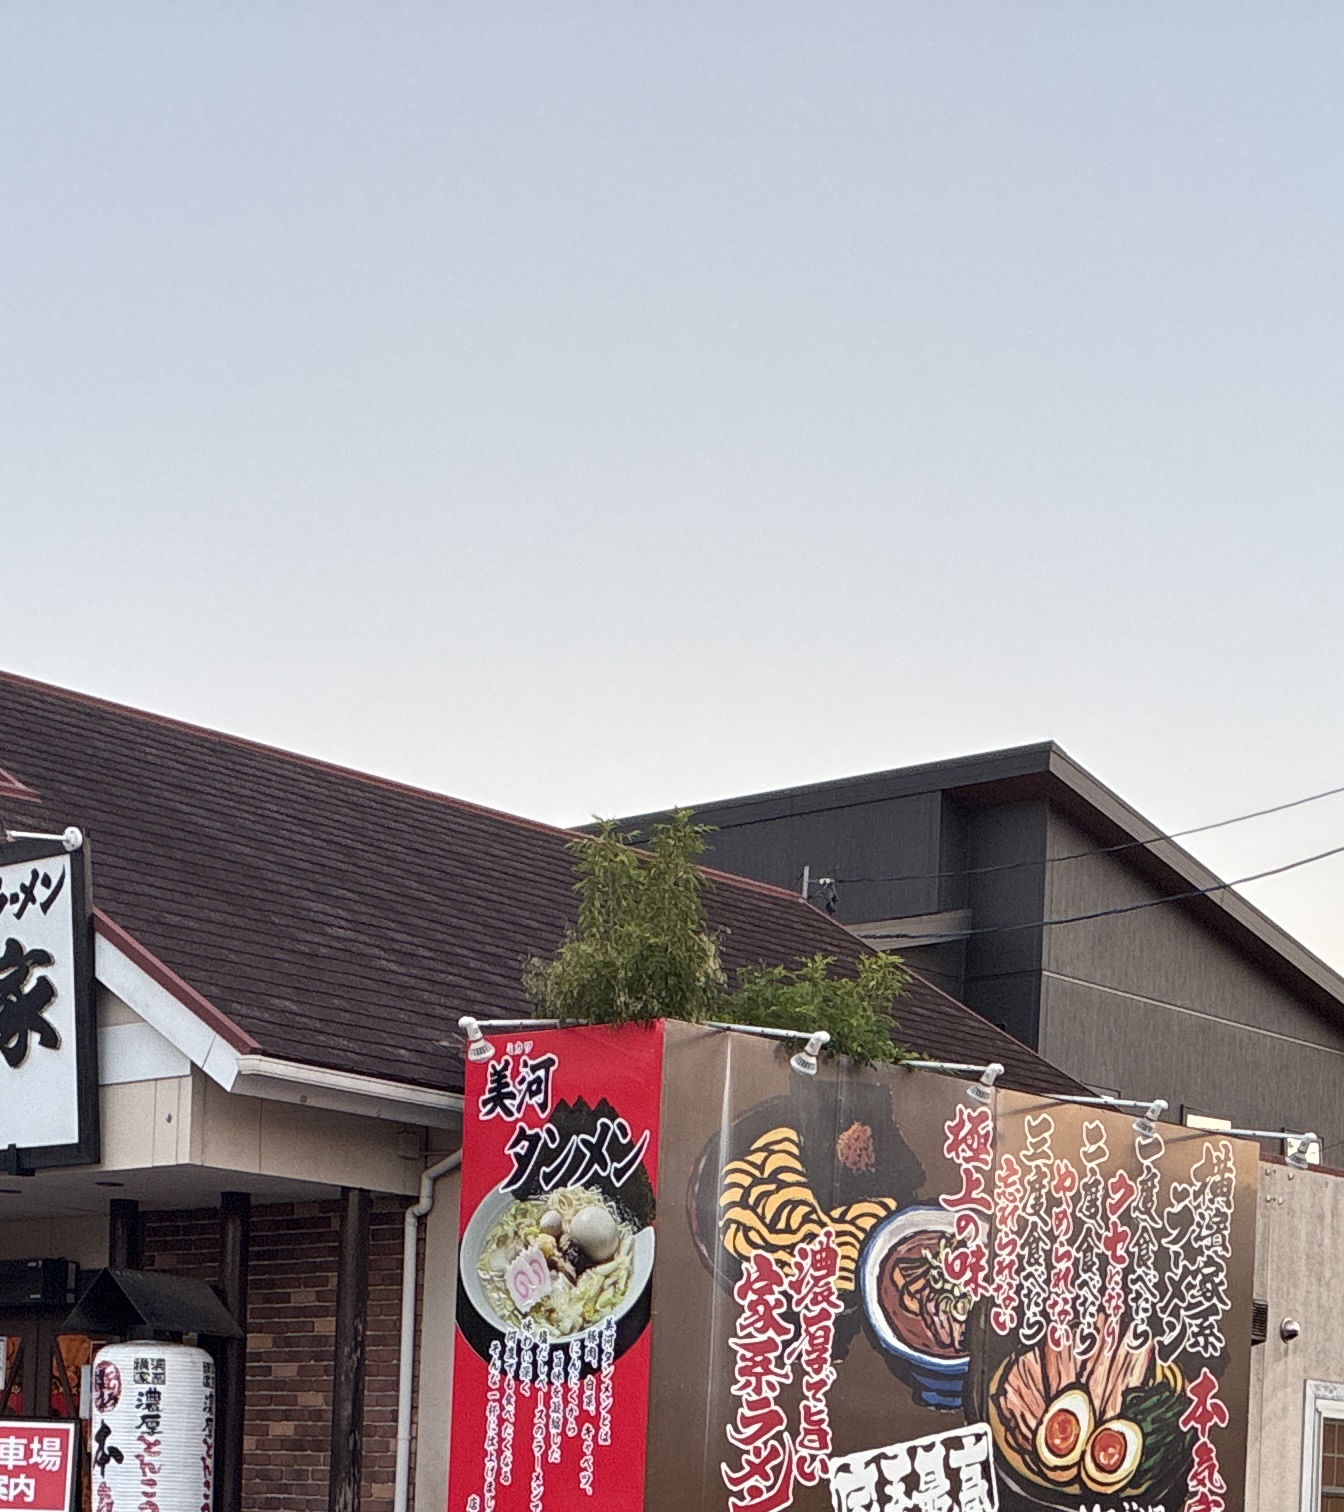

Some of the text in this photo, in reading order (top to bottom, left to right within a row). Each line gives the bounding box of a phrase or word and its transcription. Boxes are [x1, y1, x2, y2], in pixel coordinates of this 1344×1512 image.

[479, 1053, 558, 1120] 美河
[499, 1117, 650, 1193] タンメン
[1156, 1182, 1198, 1366] ラーメン
